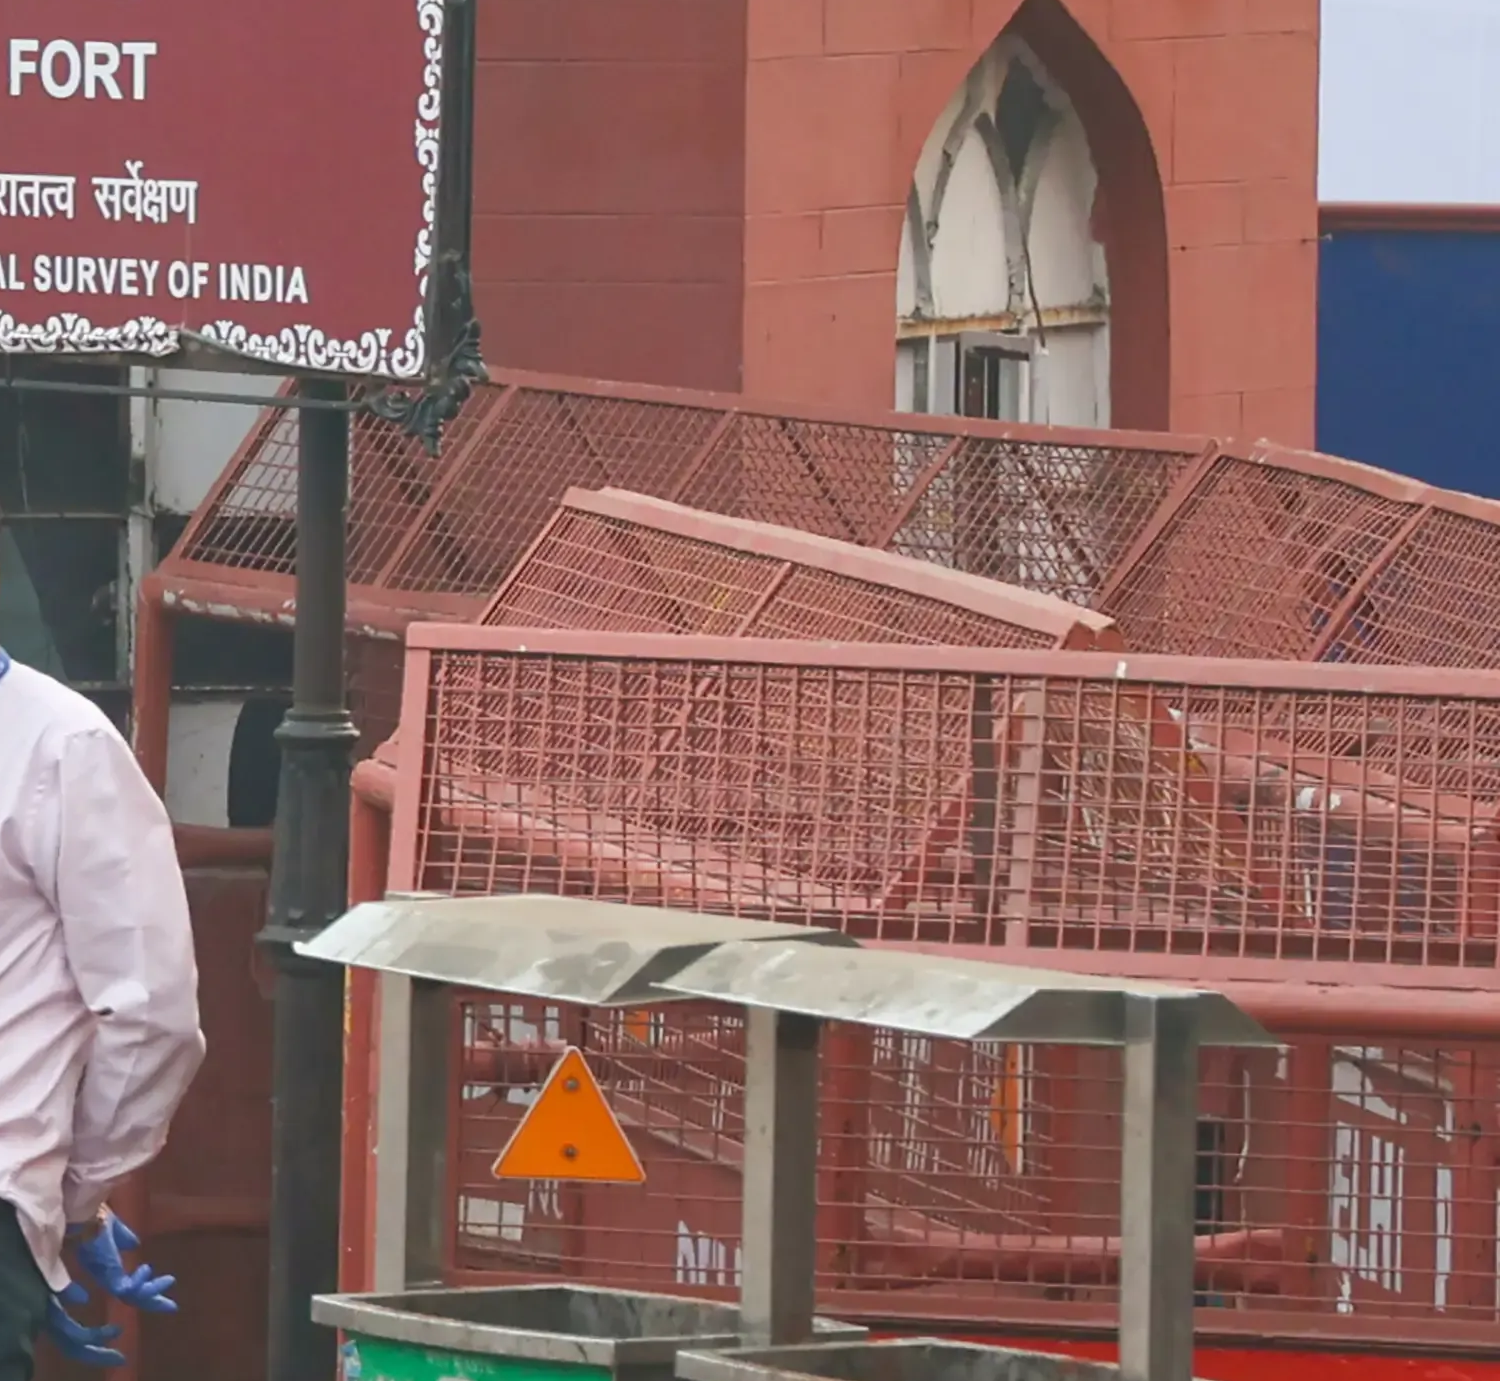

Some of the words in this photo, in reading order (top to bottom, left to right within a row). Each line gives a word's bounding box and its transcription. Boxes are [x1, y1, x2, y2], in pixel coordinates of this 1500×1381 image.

[9, 38, 157, 101] FORT
[91, 159, 199, 225] सर्वेक्षण
[33, 254, 160, 297] SURVEY
[167, 260, 210, 299] OF
[219, 262, 309, 304] INDIA
